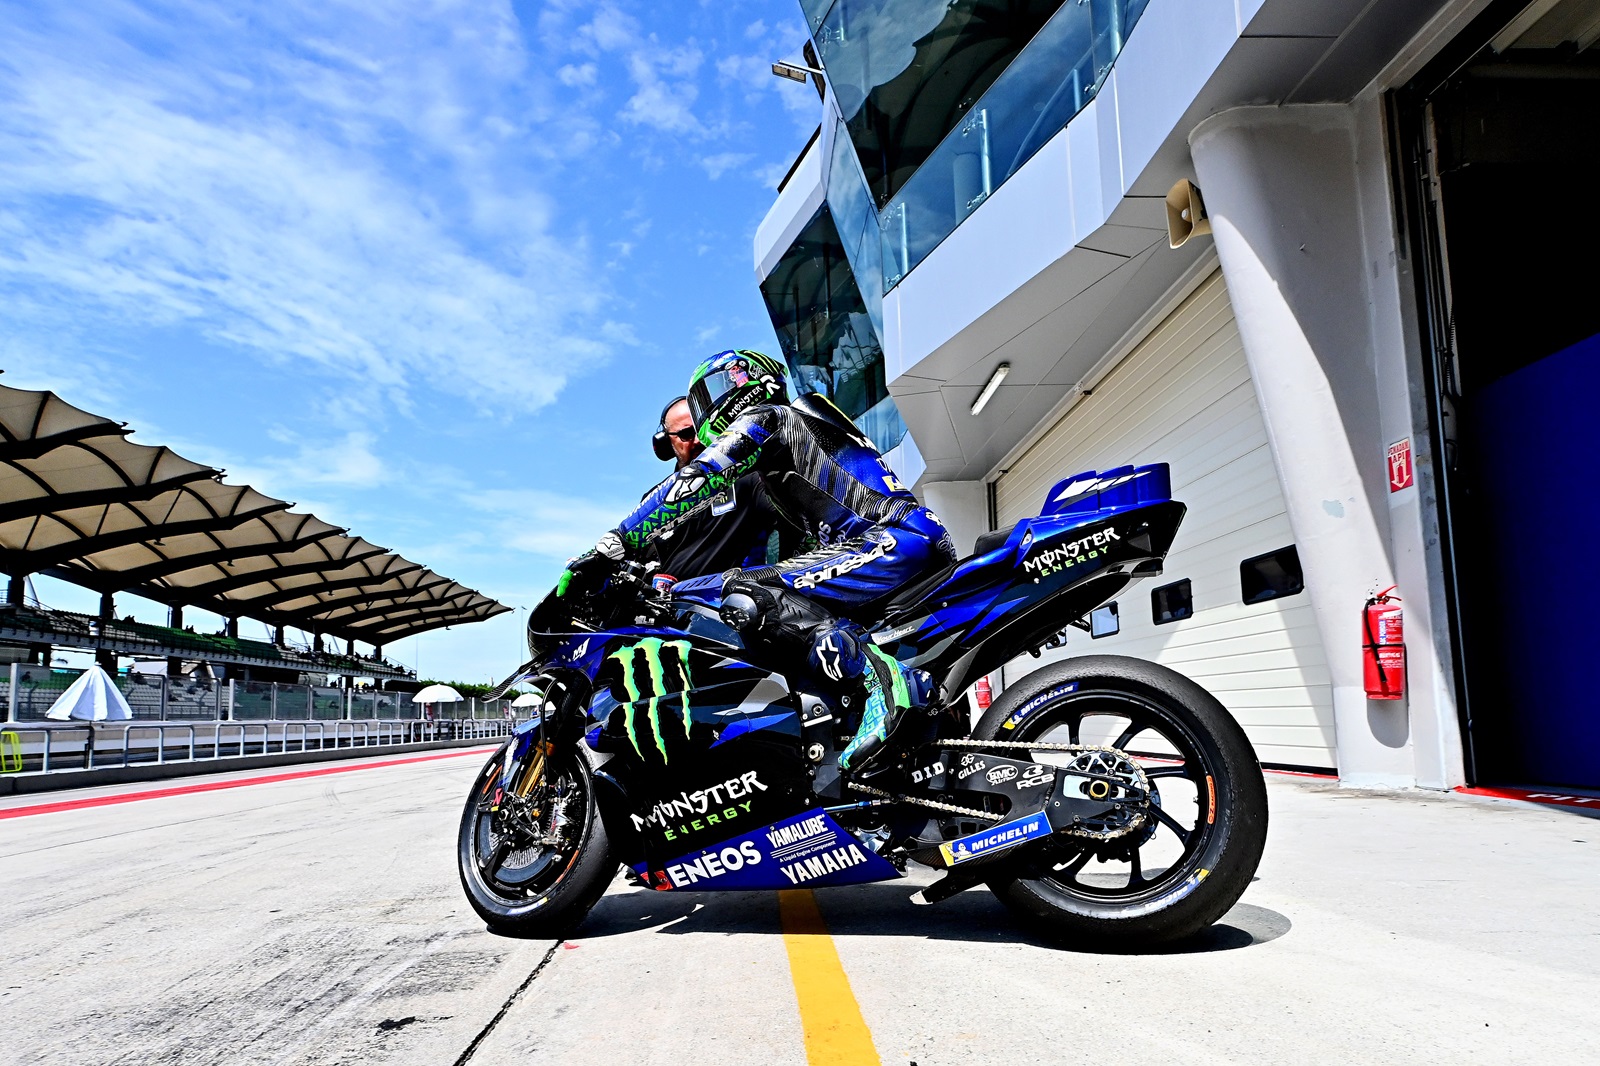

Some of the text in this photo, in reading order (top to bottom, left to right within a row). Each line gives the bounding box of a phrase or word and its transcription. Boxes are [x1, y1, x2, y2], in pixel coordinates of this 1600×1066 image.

[728, 385, 764, 418] MONSTER
[1392, 451, 1405, 463] API
[1023, 526, 1121, 573] MONSTER
[1041, 546, 1109, 577] ENERGY
[1020, 685, 1074, 716] MICHELIN
[911, 761, 945, 784] D.I.D
[958, 760, 986, 780] GILLES
[990, 767, 1015, 781] BMC
[1016, 773, 1055, 790] RCB
[630, 770, 768, 832] MONSTER
[664, 800, 751, 841] ENERGY
[765, 814, 829, 849] YAMALUBE
[796, 849, 811, 857] Engine
[810, 840, 837, 852] Component
[971, 821, 1040, 852] MICHELIN
[666, 841, 762, 888] ENEOS
[780, 843, 868, 885] YAMAHA
